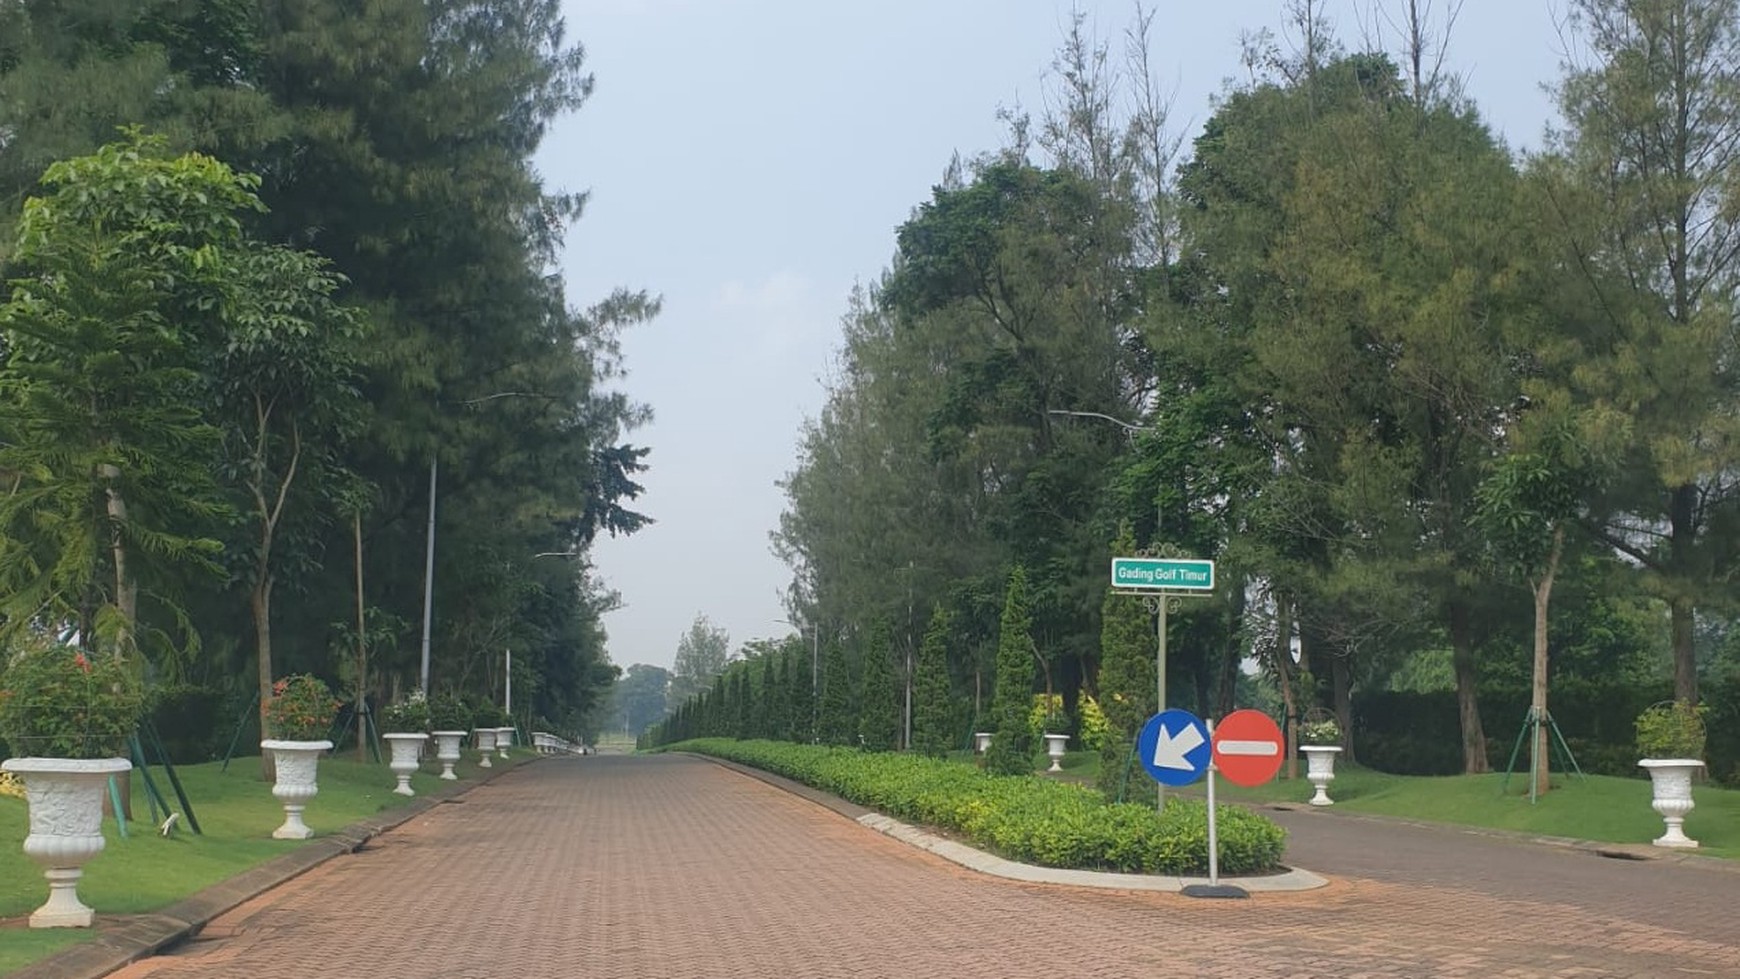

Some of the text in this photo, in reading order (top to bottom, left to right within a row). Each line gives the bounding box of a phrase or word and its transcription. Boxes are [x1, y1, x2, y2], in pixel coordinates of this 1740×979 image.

[1118, 567, 1207, 582] Gading Golf Timur
